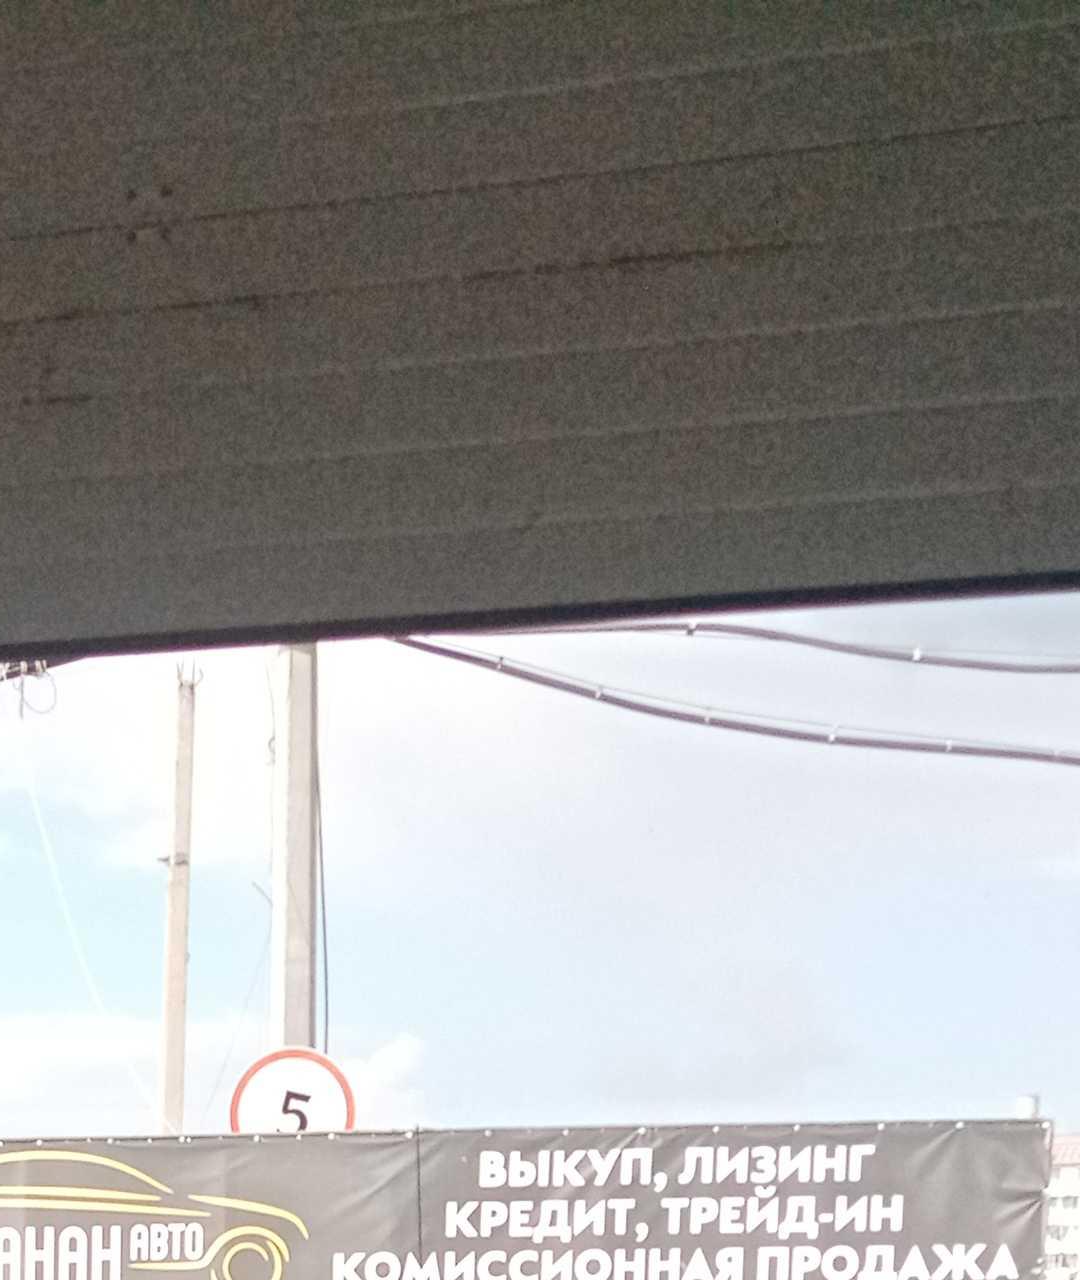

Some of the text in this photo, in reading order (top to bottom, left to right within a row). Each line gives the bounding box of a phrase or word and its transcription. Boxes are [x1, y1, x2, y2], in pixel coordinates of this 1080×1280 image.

[282, 1090, 311, 1131] 5
[477, 1144, 876, 1191] ВЫКУП, ЛИЗИНГ
[444, 1187, 903, 1243] КРЕДИТ, ТРЕЙД-ИН
[129, 1222, 204, 1261] АВТО
